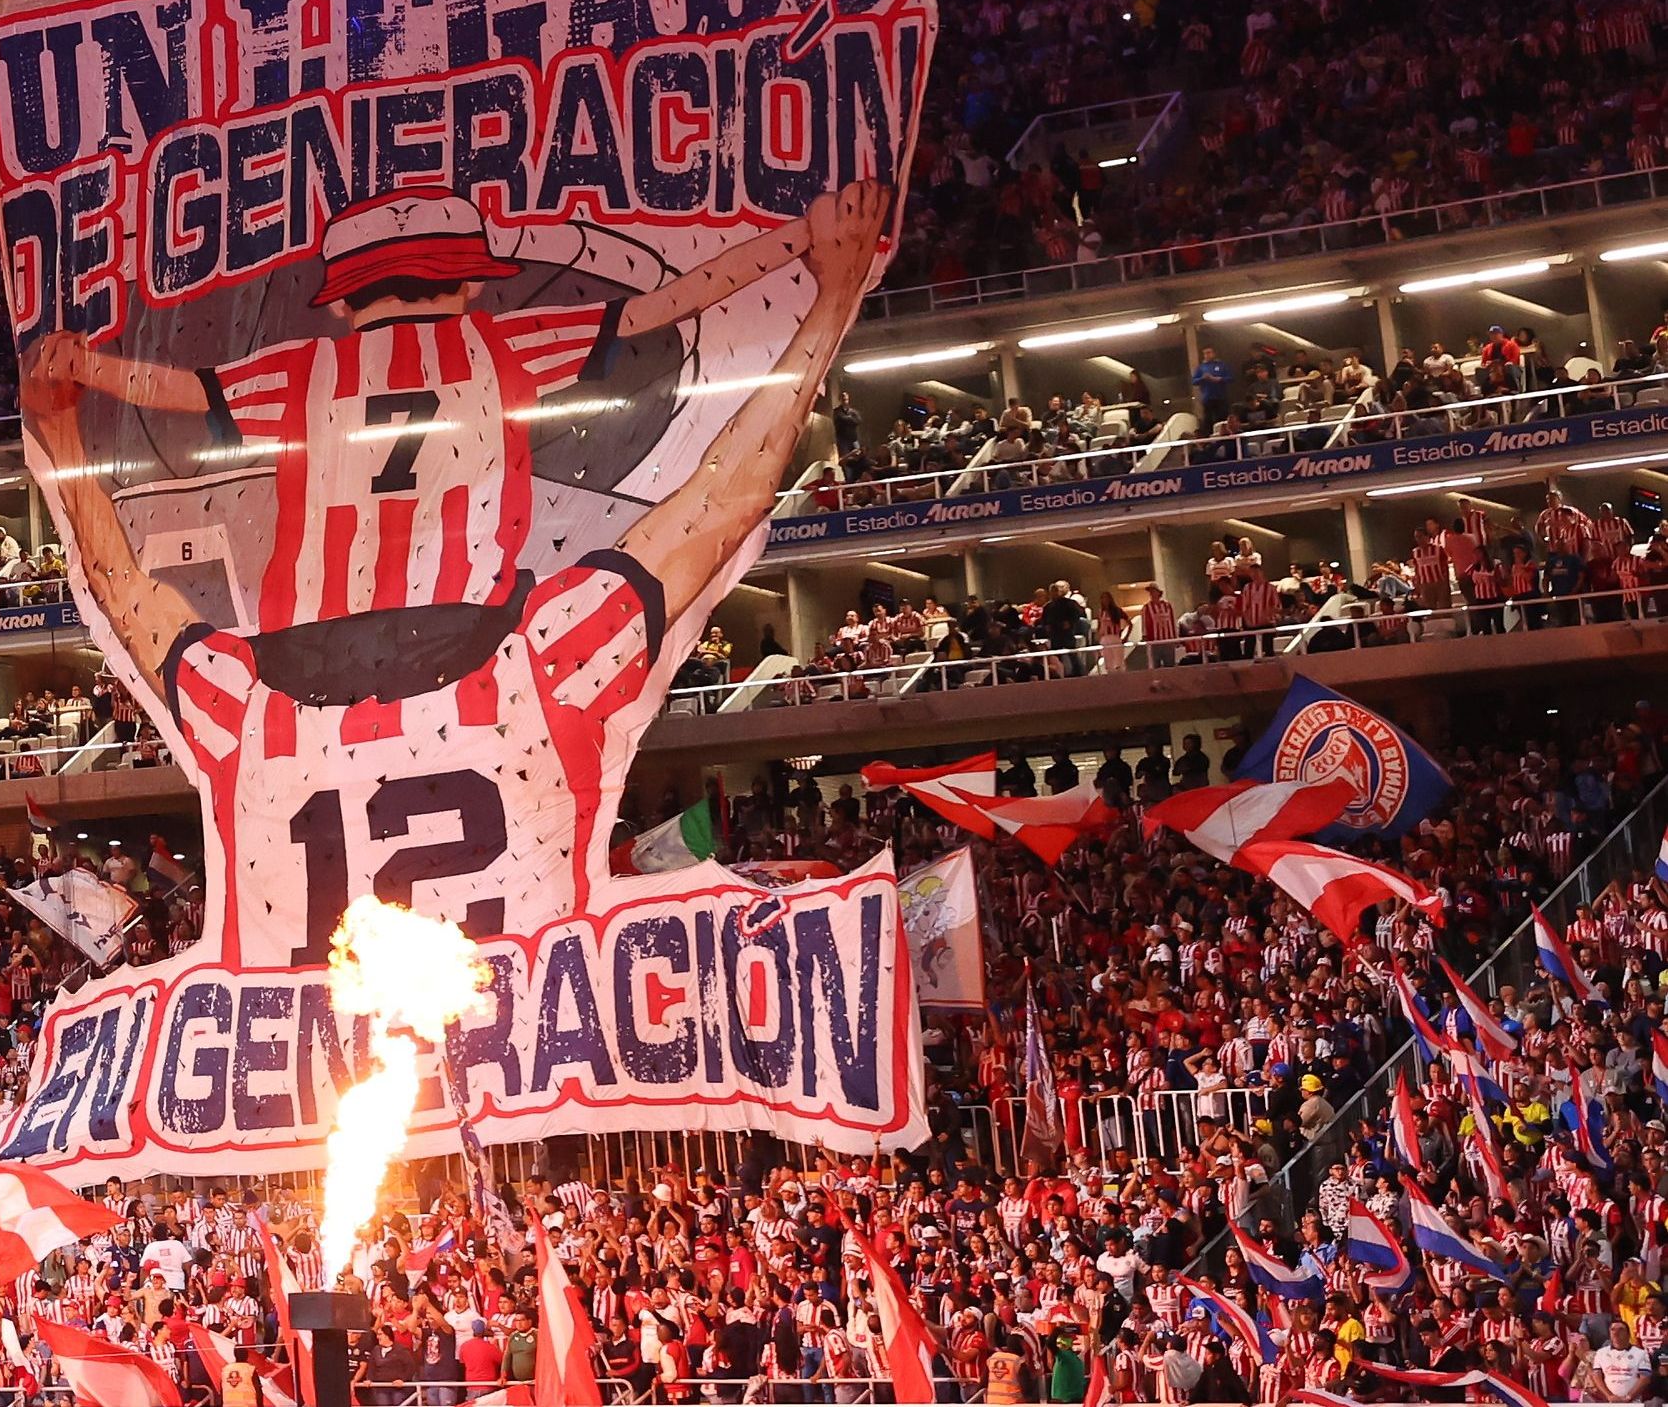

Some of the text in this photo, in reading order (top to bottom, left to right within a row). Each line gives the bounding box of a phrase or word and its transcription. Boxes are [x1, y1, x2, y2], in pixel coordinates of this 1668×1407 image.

[2, 6, 923, 352] DE GENERACIÓN
[364, 390, 441, 494] 7
[1394, 428, 1568, 465] Estadio AKRON
[1203, 454, 1371, 488] Estadio AKRON
[1020, 479, 1182, 512] Estadio AKRON
[771, 521, 827, 543] KRON
[846, 501, 1000, 533] Estadio AKRON
[182, 541, 193, 562] 6
[289, 769, 507, 966] 12
[160, 893, 882, 1135] GENRACIÓN
